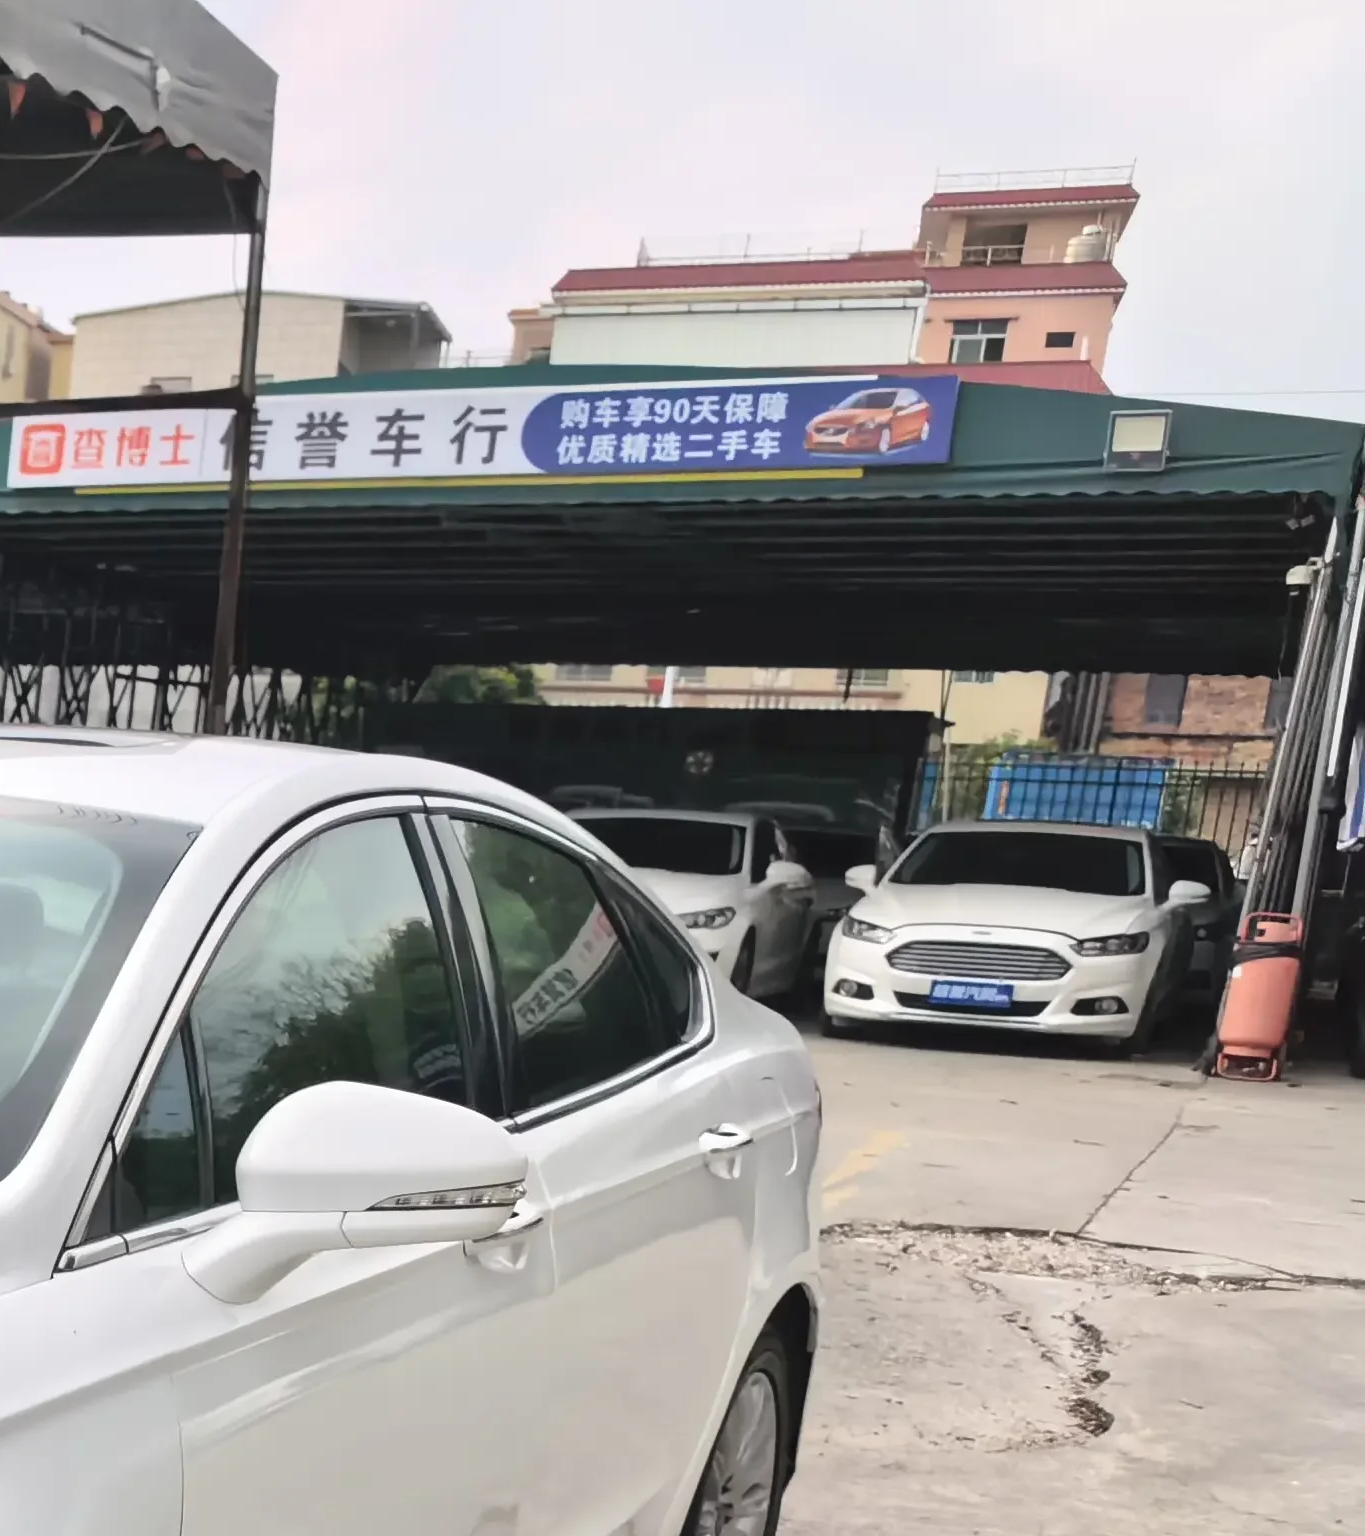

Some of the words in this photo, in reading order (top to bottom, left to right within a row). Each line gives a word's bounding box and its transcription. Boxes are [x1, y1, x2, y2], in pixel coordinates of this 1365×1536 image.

[559, 391, 790, 430] 购车享90天保障
[70, 423, 196, 470] 查博士
[556, 428, 783, 466] 优质精选二手车
